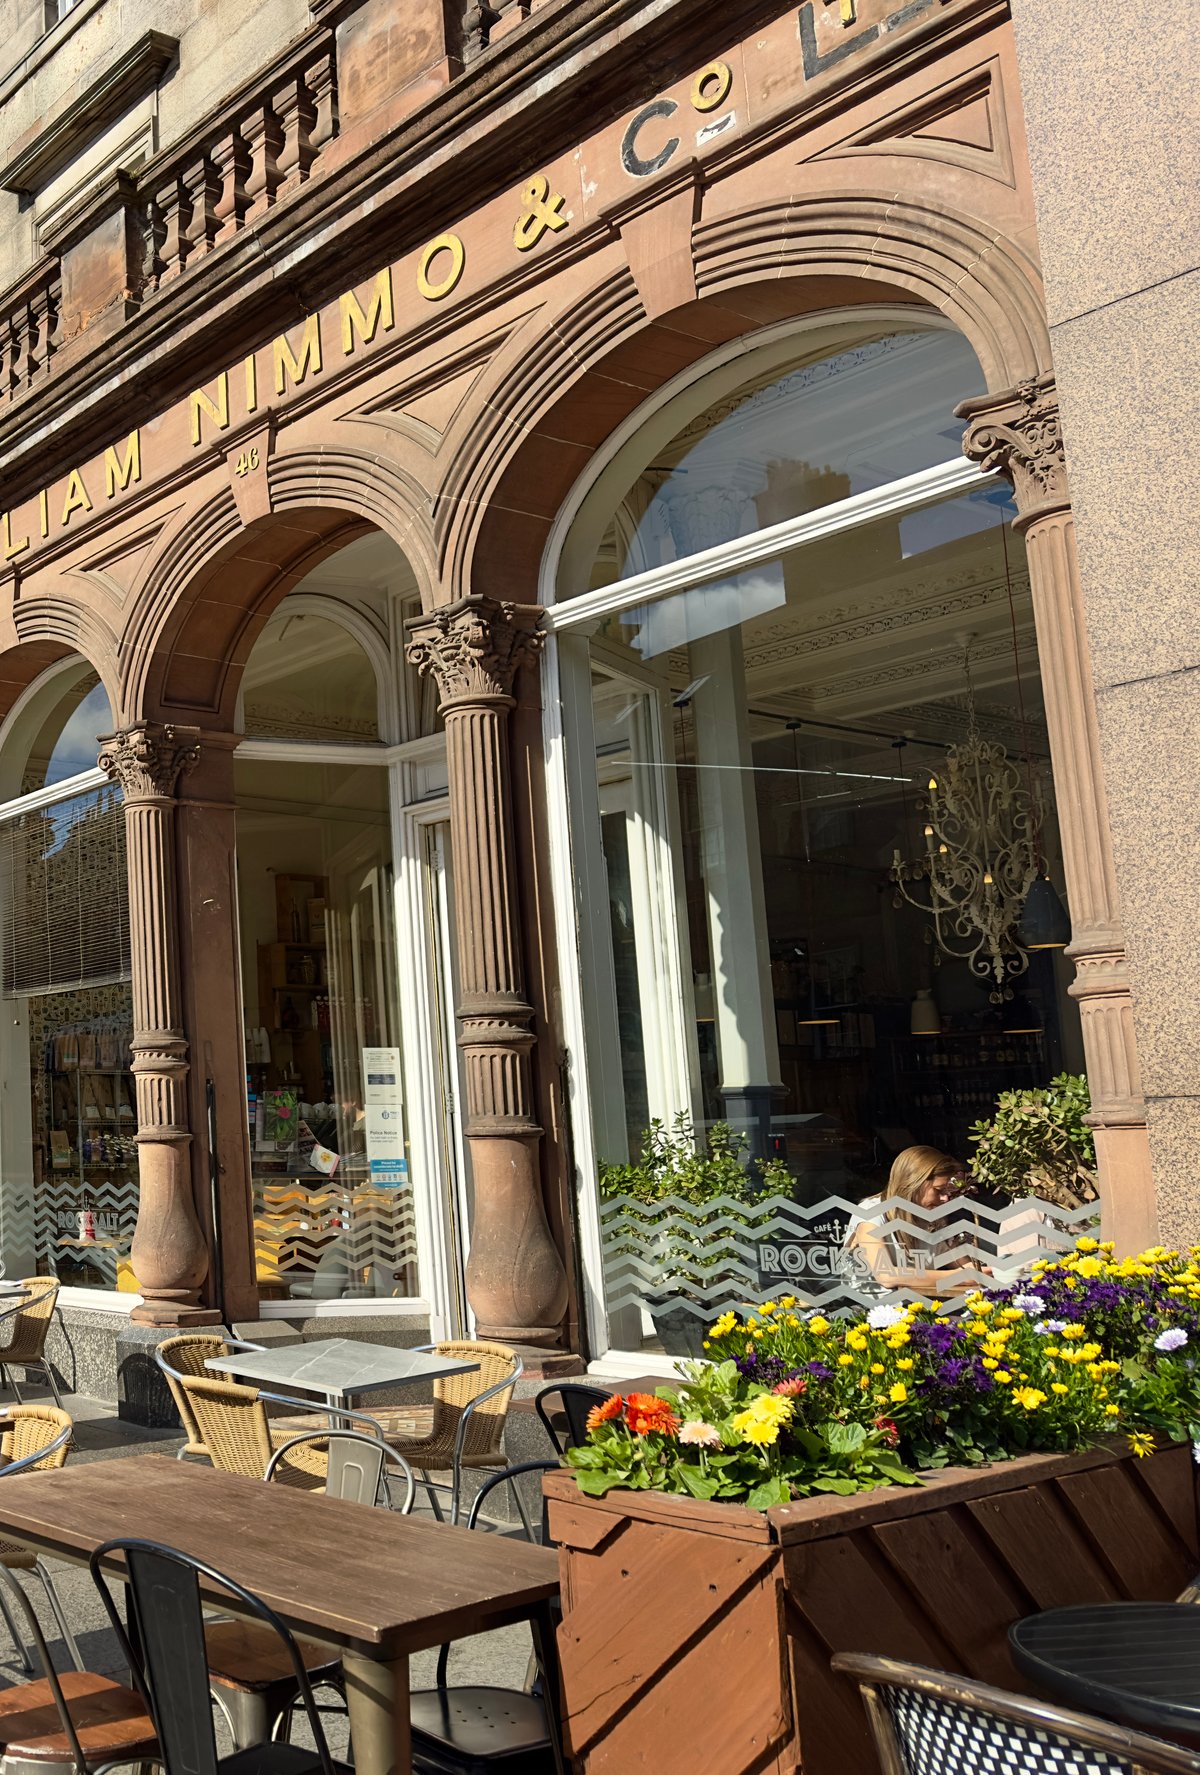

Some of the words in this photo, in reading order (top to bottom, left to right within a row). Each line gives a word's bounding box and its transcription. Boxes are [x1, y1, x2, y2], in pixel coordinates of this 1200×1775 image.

[189, 233, 466, 446] NIMMO
[513, 174, 569, 252] &
[235, 447, 260, 478] 46
[814, 1223, 832, 1233] CAFÉ
